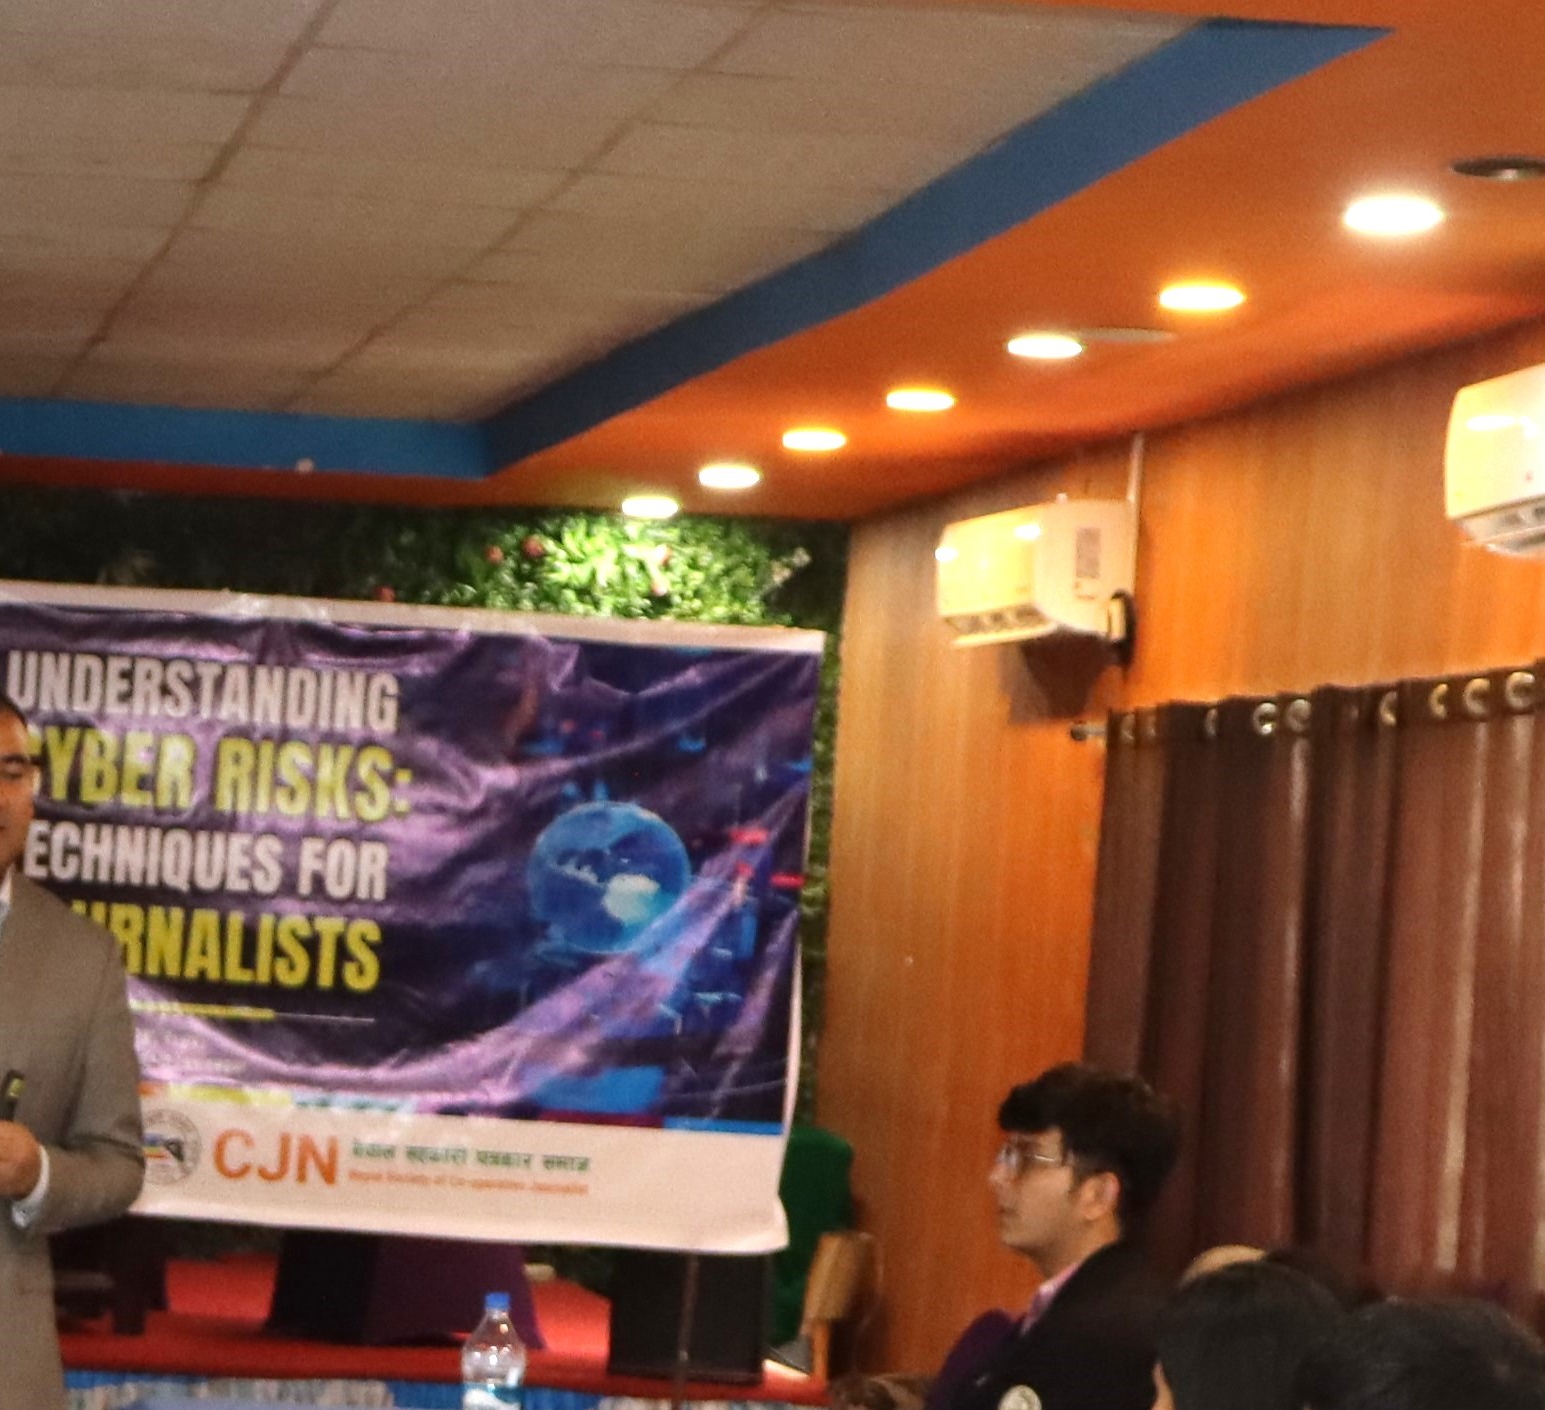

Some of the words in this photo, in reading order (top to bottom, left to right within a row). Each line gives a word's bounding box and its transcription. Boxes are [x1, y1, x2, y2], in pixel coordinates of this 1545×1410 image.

[7, 650, 399, 734] UNDERSTANDING
[215, 736, 411, 823] RISKS:
[23, 819, 284, 893] ECHNIQUES
[298, 837, 389, 900] FOR
[213, 1128, 339, 1186] CJN
